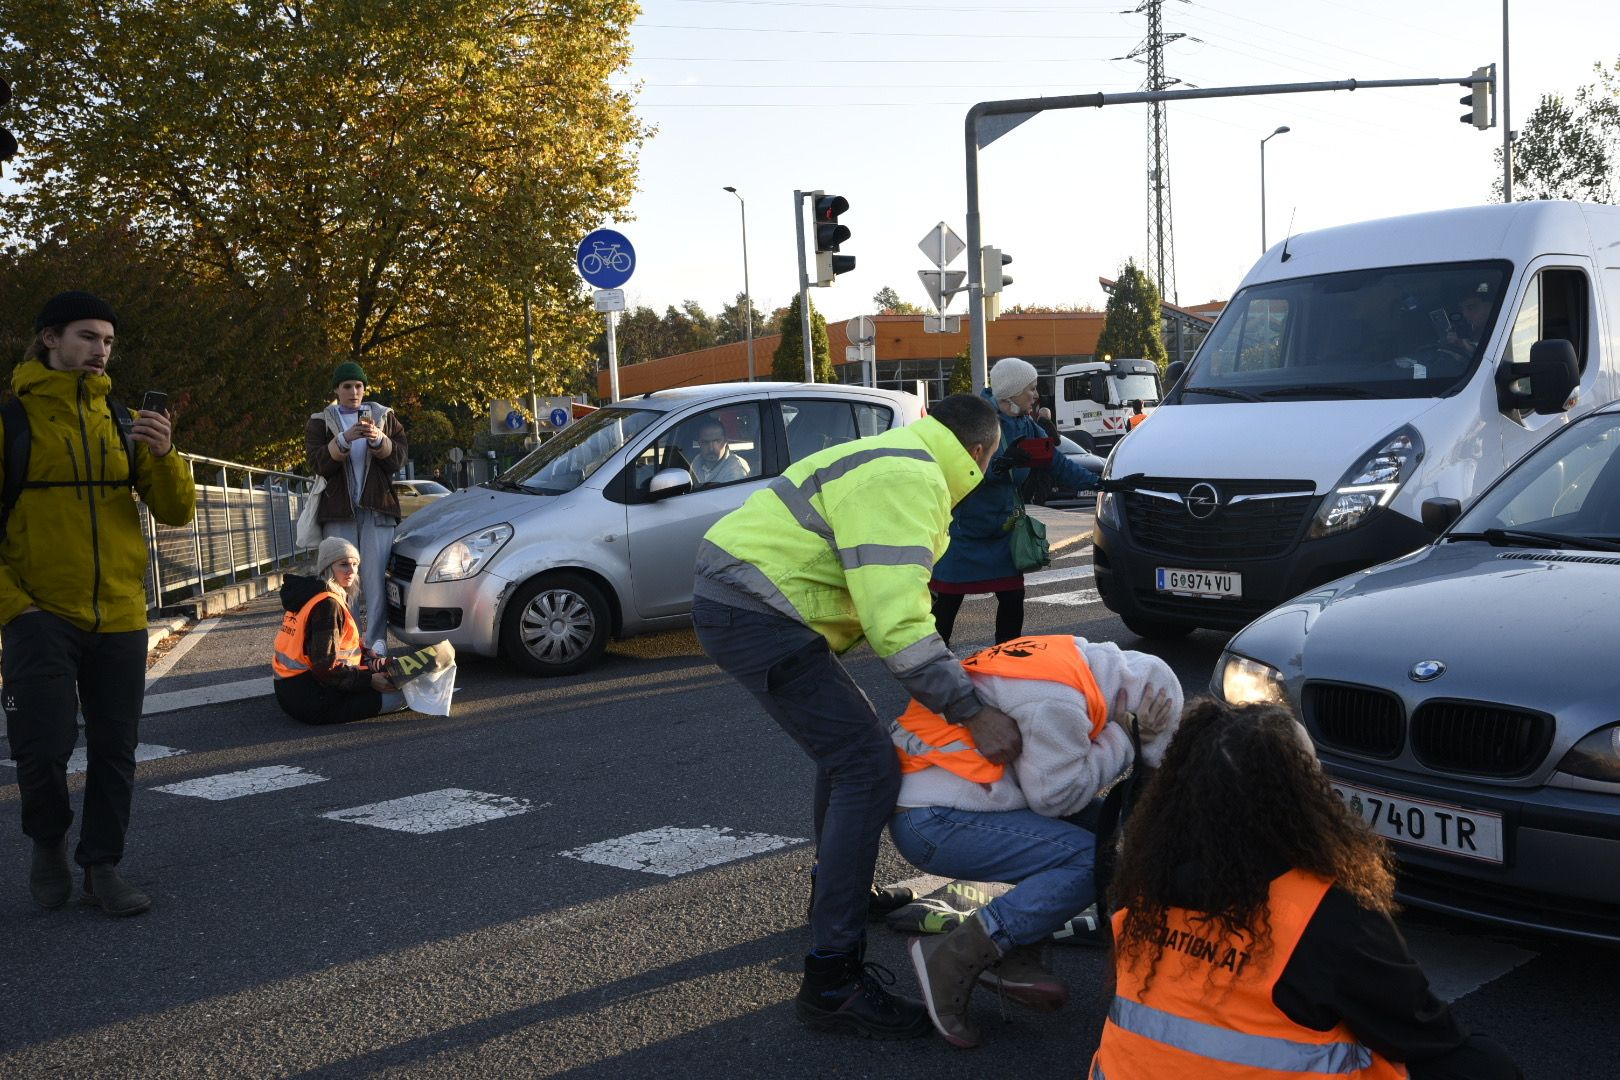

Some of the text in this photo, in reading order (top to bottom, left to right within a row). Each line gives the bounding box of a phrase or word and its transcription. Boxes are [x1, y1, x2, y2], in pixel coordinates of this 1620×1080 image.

[1171, 572, 1231, 591] G 974 VU
[1367, 798, 1477, 851] 740 TR
